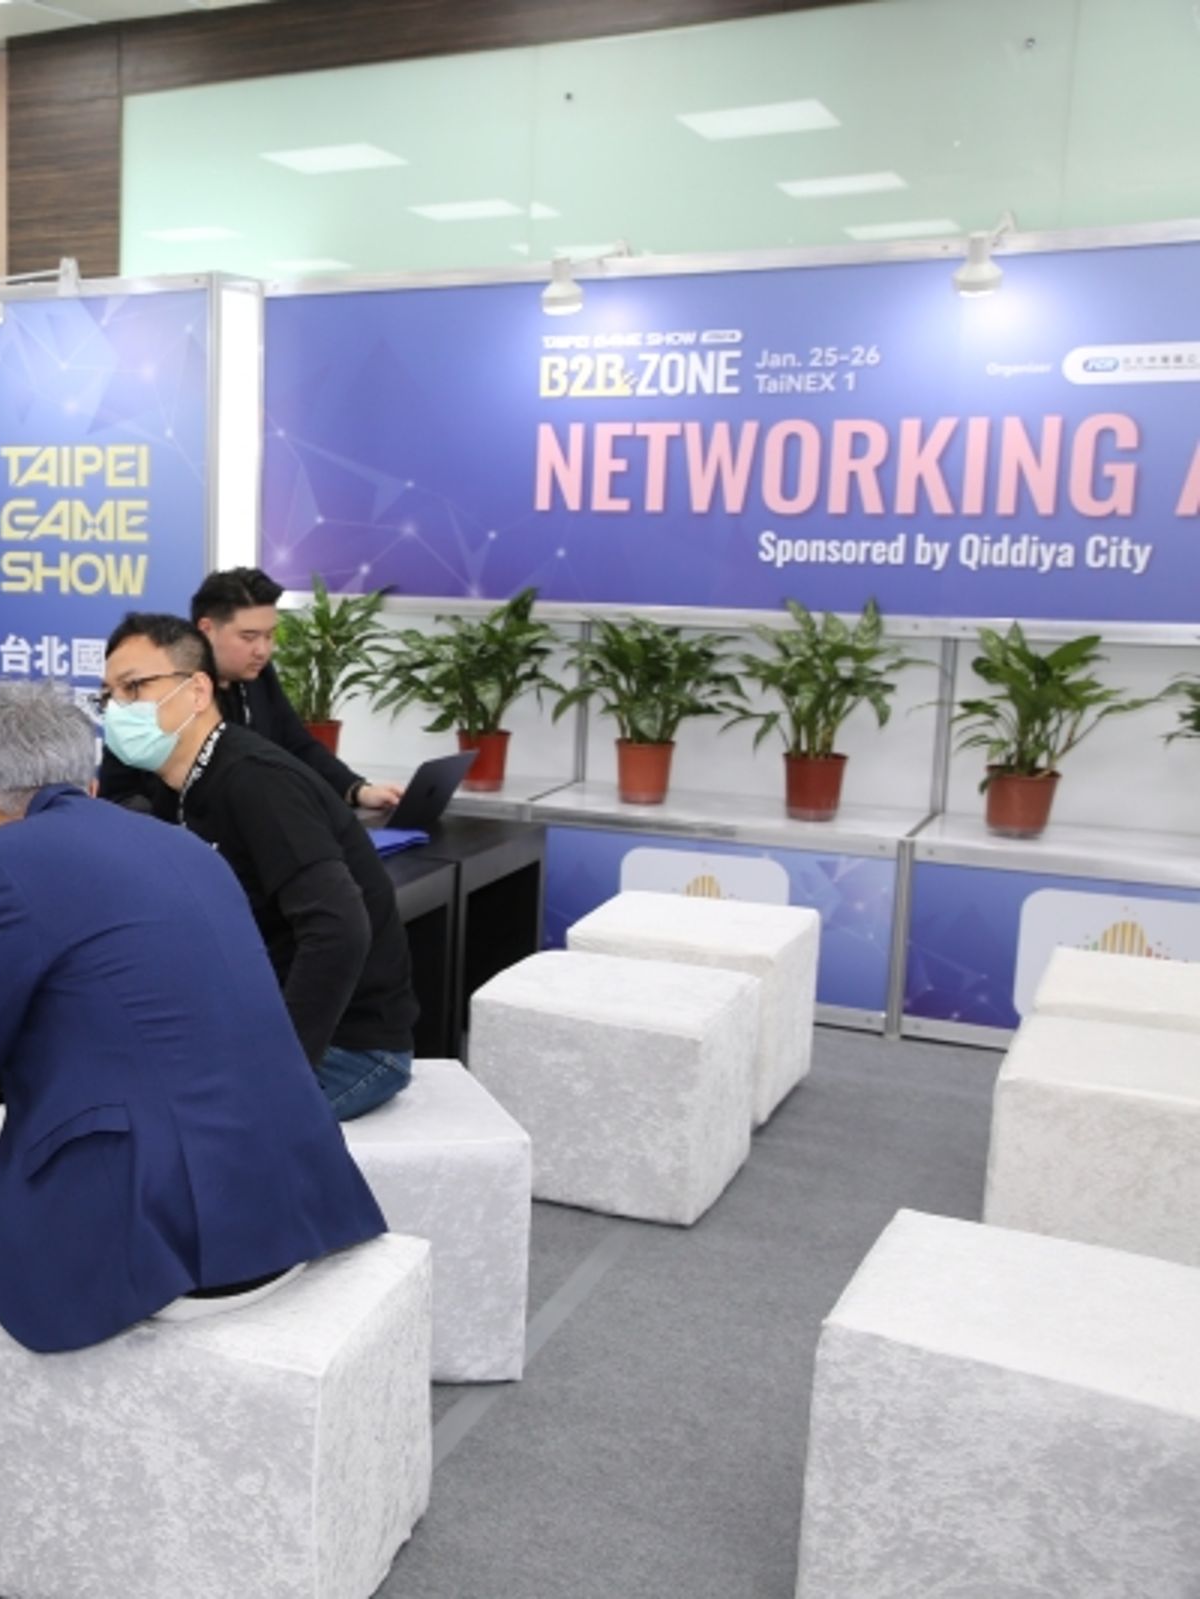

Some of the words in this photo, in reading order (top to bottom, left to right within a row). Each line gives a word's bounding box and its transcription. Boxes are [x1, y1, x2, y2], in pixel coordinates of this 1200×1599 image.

[645, 331, 697, 346] SHOW
[755, 350, 803, 369] Jan.
[809, 346, 881, 367] 25-26
[636, 351, 742, 395] ZONE
[755, 374, 836, 394] TaiNEX
[845, 372, 856, 391] 1
[0, 445, 148, 487] TAIPEI
[534, 413, 1139, 517] NETWORKING
[0, 499, 148, 541] GAME
[0, 551, 148, 595] SHOW
[758, 531, 906, 568] Sponsored
[914, 533, 949, 571] by
[959, 533, 1075, 573] Qiddiya
[1085, 535, 1152, 574] City
[0, 634, 107, 677] 台北國
